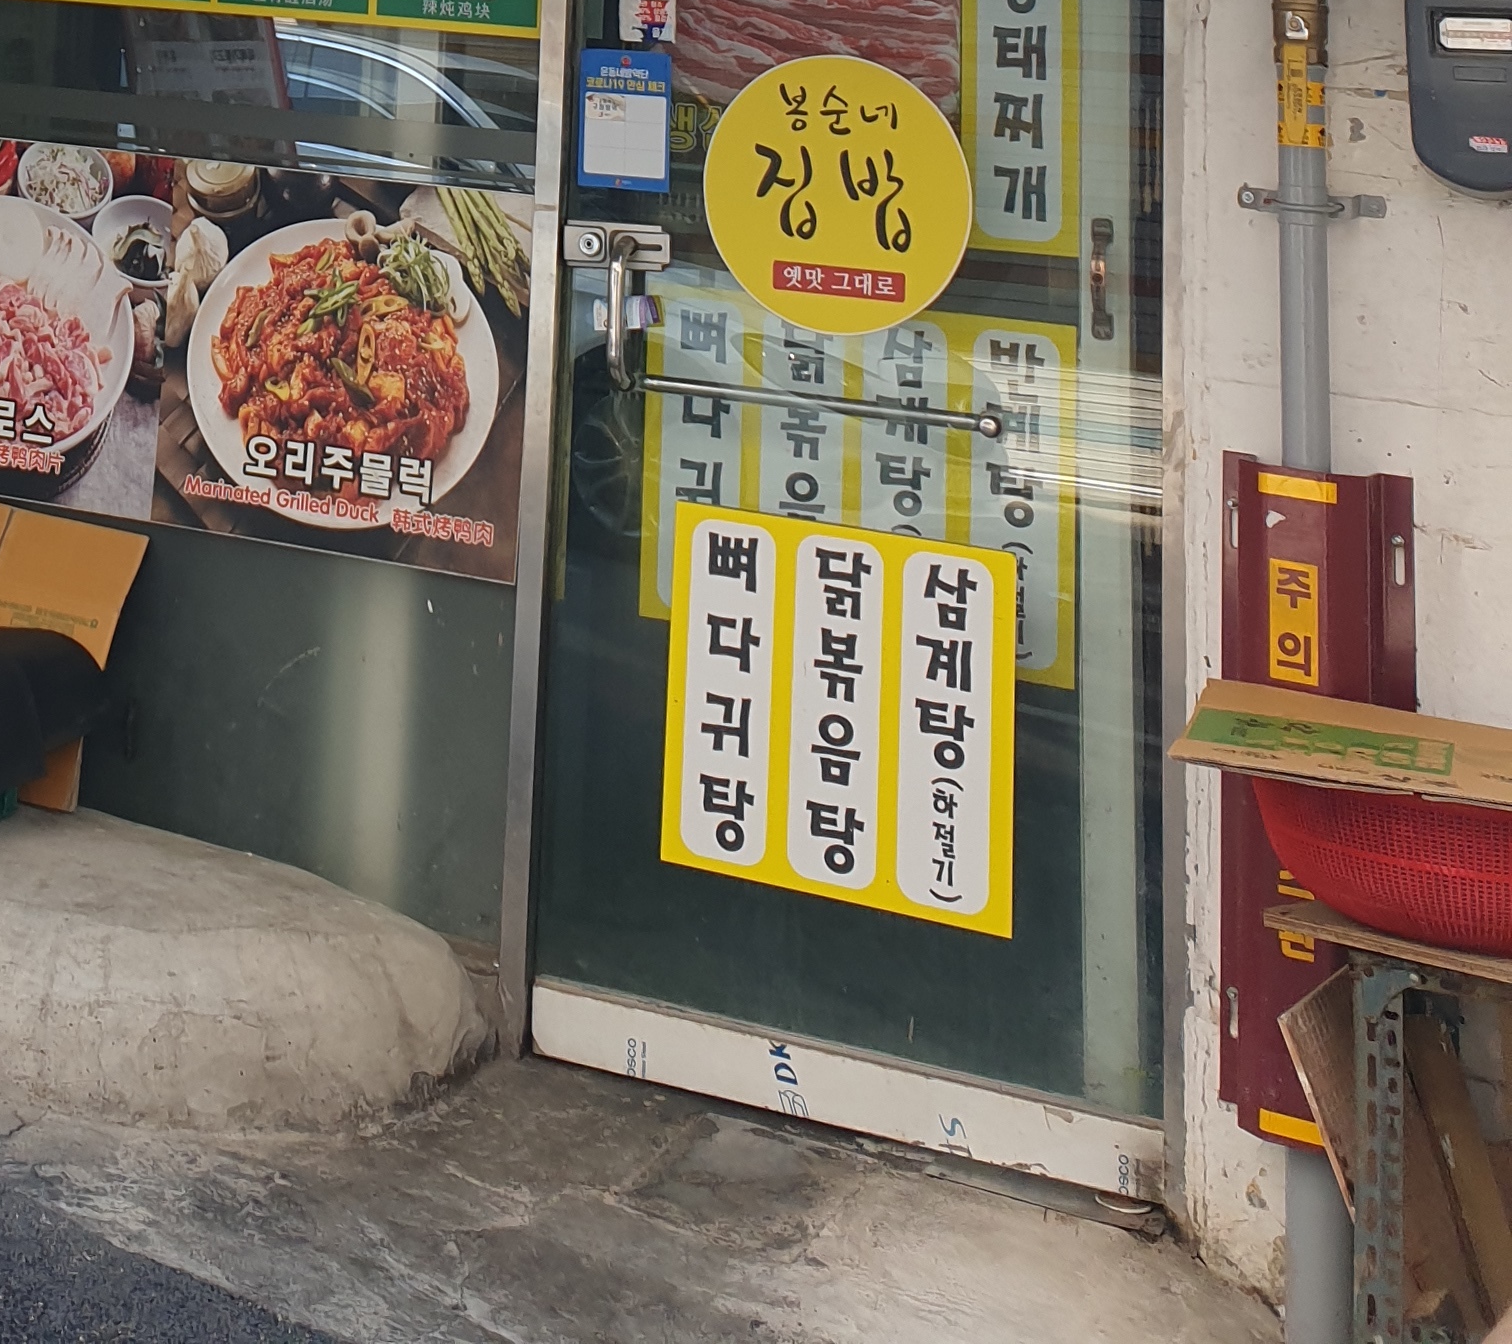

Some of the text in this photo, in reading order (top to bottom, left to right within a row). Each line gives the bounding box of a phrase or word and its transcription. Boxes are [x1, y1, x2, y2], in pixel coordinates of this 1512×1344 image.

[779, 82, 899, 134] 봉순네
[754, 143, 912, 253] 집밥
[783, 266, 896, 297] 옛맛 그대로
[184, 475, 380, 524] Marinated Grilled Duck
[243, 434, 434, 505] 오리주물럭
[390, 509, 494, 547] 韩式烤鸭肉
[1276, 566, 1314, 680] 주의
[699, 532, 761, 853] 뼈다귀탕
[805, 546, 872, 875] 닭볶음탕
